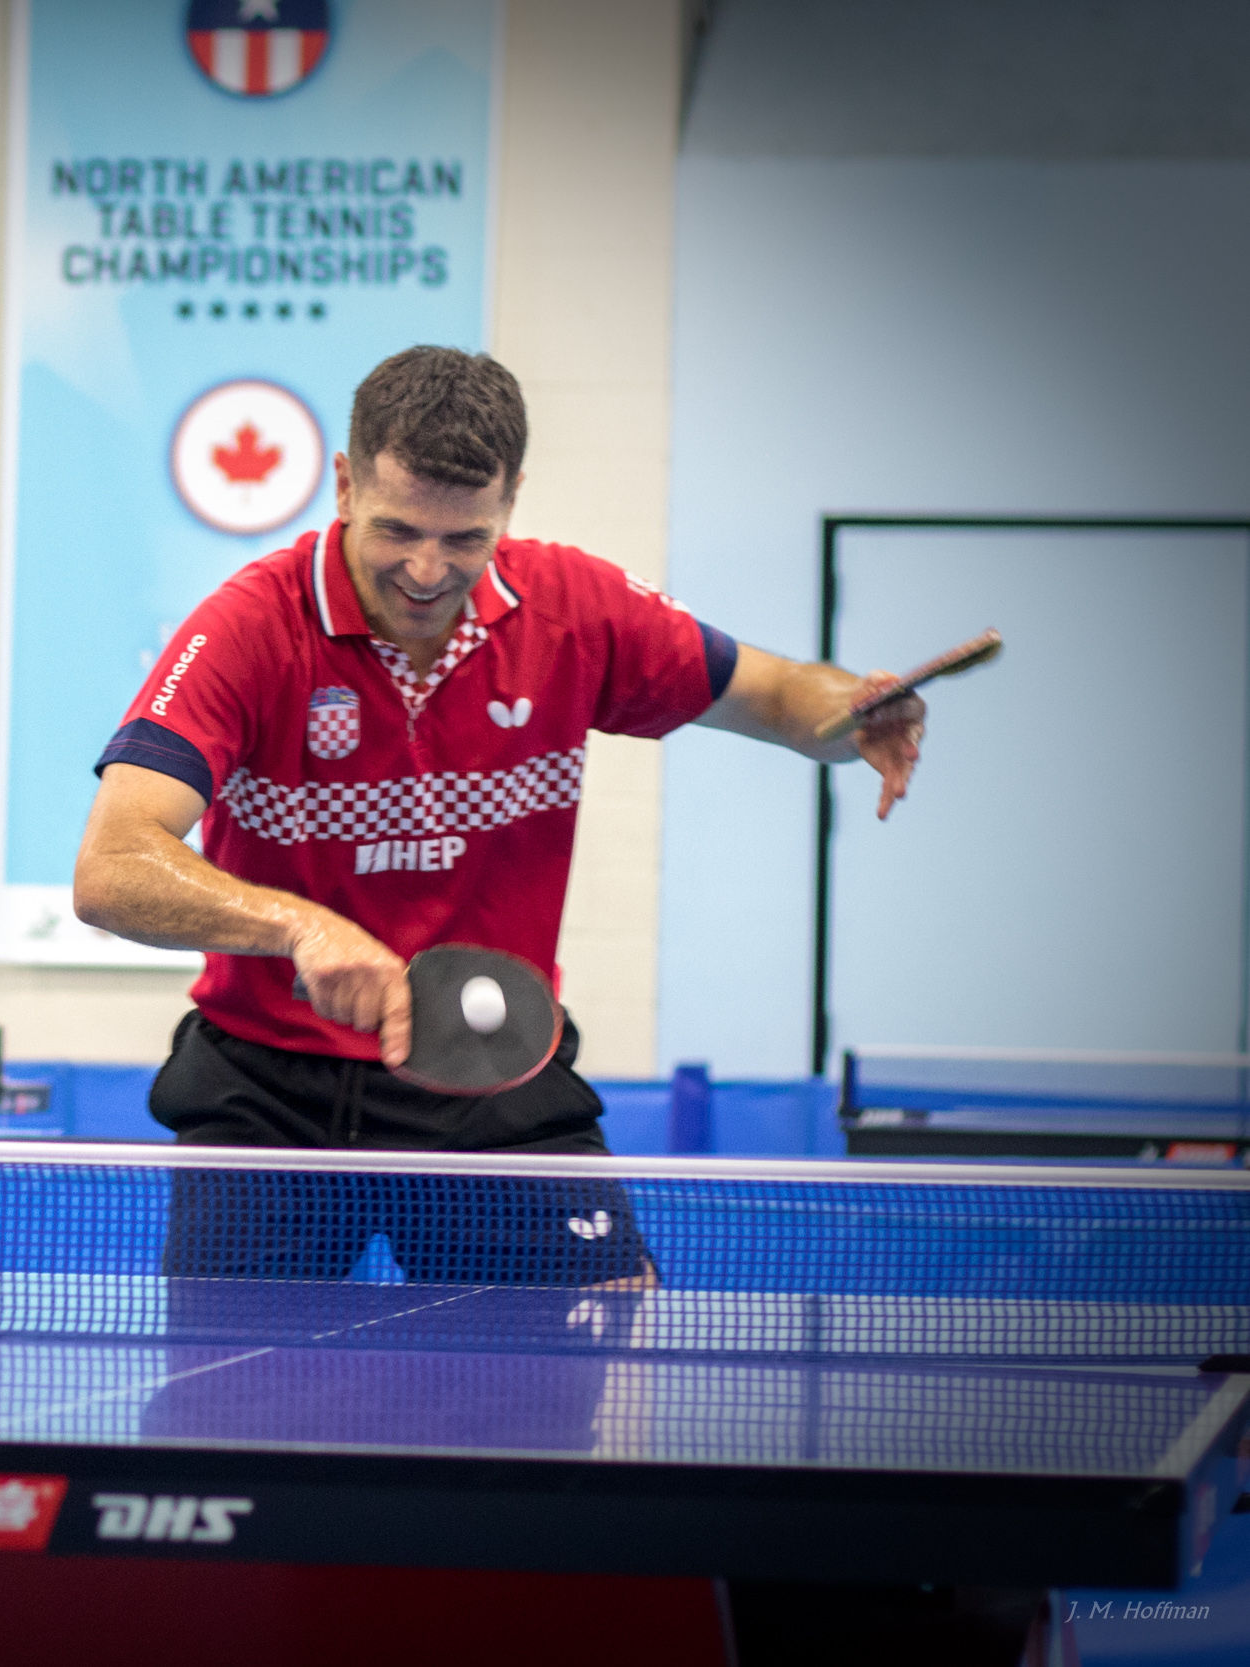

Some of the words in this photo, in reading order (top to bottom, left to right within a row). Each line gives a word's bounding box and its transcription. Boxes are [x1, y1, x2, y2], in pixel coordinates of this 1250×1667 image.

[52, 159, 207, 197] NORTH
[222, 159, 463, 197] AMERICAN
[98, 202, 230, 240] TABLE
[251, 202, 416, 240] TENNIS
[62, 245, 449, 286] CHAMPIONSHIPS
[391, 836, 467, 872] HEP
[93, 1492, 254, 1543] DHS
